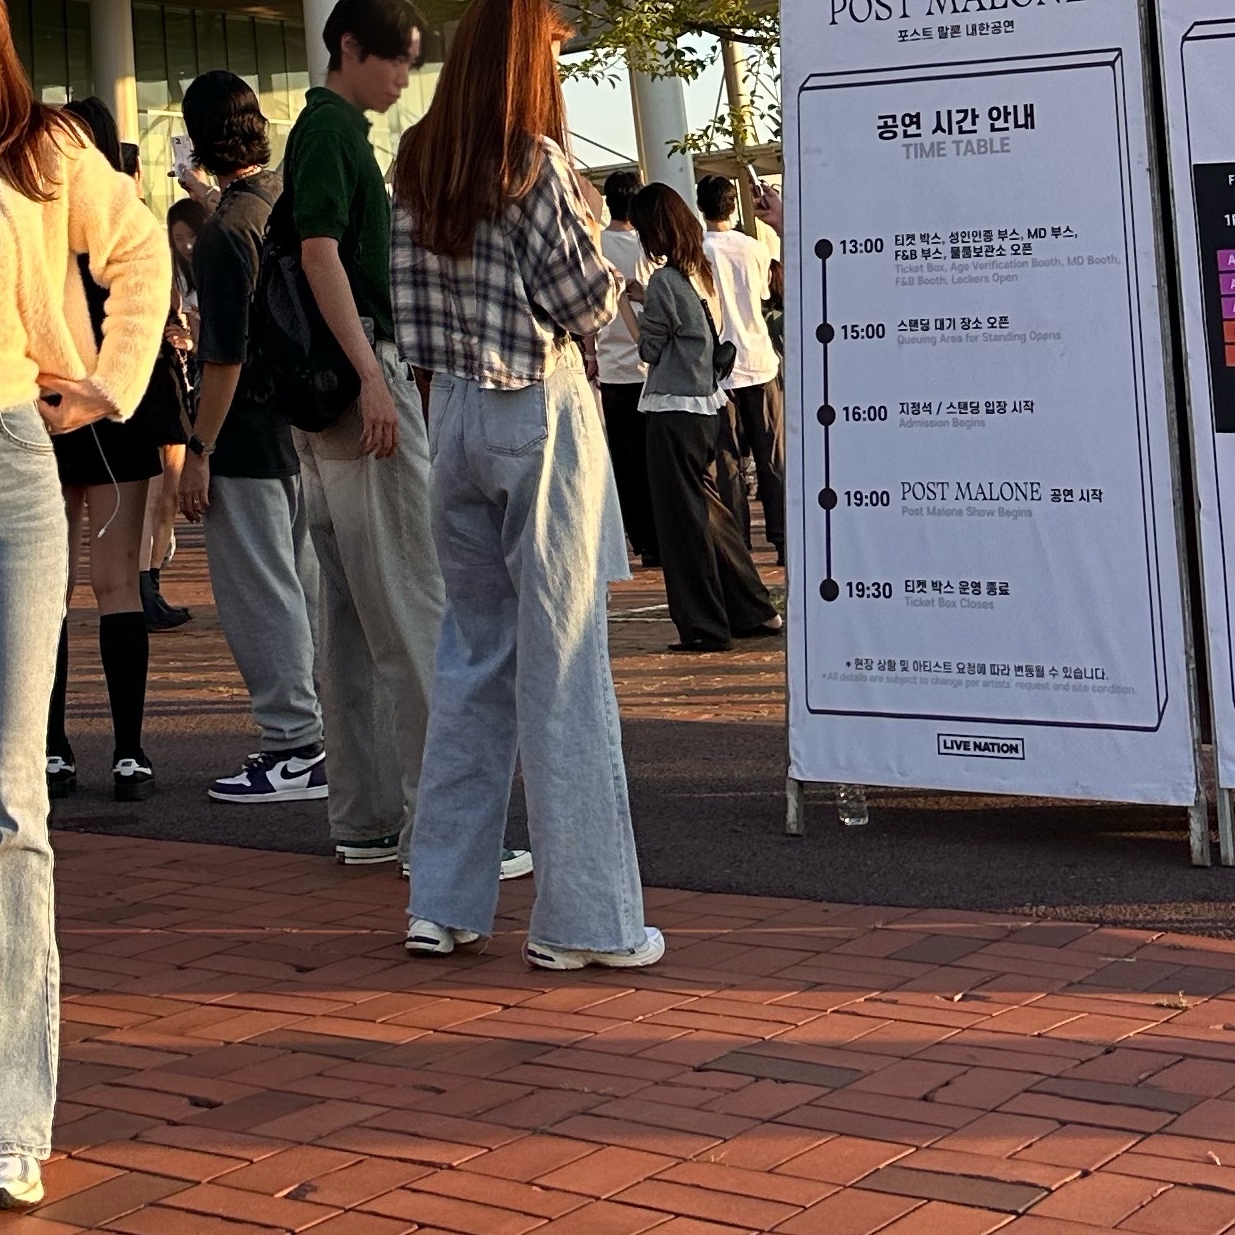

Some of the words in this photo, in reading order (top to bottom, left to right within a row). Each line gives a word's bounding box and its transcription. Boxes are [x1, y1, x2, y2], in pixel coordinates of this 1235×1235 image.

[898, 26, 933, 43] 포스트
[938, 23, 962, 40] 말론
[966, 20, 1015, 37] 내한공연
[877, 112, 921, 140] 공연
[932, 108, 979, 135] 시간
[988, 104, 1035, 132] 안내
[902, 141, 946, 159] TIME
[952, 137, 1011, 156] TABLE
[895, 233, 916, 246] 티켓
[920, 232, 945, 245] 박스,
[949, 230, 993, 244] 성인인증
[998, 229, 1024, 241] 부스,
[1027, 228, 1047, 239] MD
[1051, 226, 1078, 239] 부스,
[840, 238, 883, 254] 13:00
[895, 249, 917, 261] F&B
[921, 247, 946, 260] 부스,
[1011, 243, 1032, 256] 오픈
[895, 264, 924, 274] Ticket
[950, 262, 970, 273] Age
[972, 259, 1028, 270] Verification
[1067, 256, 1084, 266] MD
[1087, 254, 1121, 265] Booth,
[951, 274, 989, 284] Lockers
[992, 272, 1018, 285] Open
[841, 323, 886, 340] 15:00
[935, 317, 956, 330] 대기
[960, 317, 983, 330] 장소
[987, 316, 1009, 329] 오픈
[897, 335, 937, 346] Queuing
[940, 334, 962, 344] Area
[966, 333, 979, 343] for
[982, 332, 1026, 344] Standing
[1029, 331, 1061, 342] Opens
[842, 405, 888, 422] 16:00
[899, 401, 932, 415] 지정석
[984, 400, 1007, 414] 입장
[1011, 400, 1035, 413] 시작
[899, 418, 950, 429] Admission
[952, 418, 986, 430] Begins
[844, 490, 890, 507] 19:00
[901, 481, 950, 502] POST
[955, 481, 1042, 502] MALONE
[1050, 488, 1074, 503] 공연
[1079, 488, 1103, 503] 시작
[901, 506, 924, 517] Post
[927, 506, 964, 517] Malone
[966, 506, 995, 517] Show
[998, 507, 1033, 520] Begins
[846, 581, 893, 599] 19:30
[904, 580, 927, 594] 티켓
[931, 580, 954, 595] 박스
[958, 580, 982, 595] 운영
[986, 581, 1010, 596] 종료
[904, 596, 935, 607] Ticket
[938, 597, 957, 608] Box
[960, 598, 994, 609] Closes
[855, 658, 874, 670] 현장
[900, 660, 909, 672] 및
[913, 660, 952, 673] 아티스트
[990, 663, 1010, 676] 따라
[1049, 666, 1058, 678] 수
[943, 739, 971, 751] LIVE
[973, 741, 1019, 754] NATION
